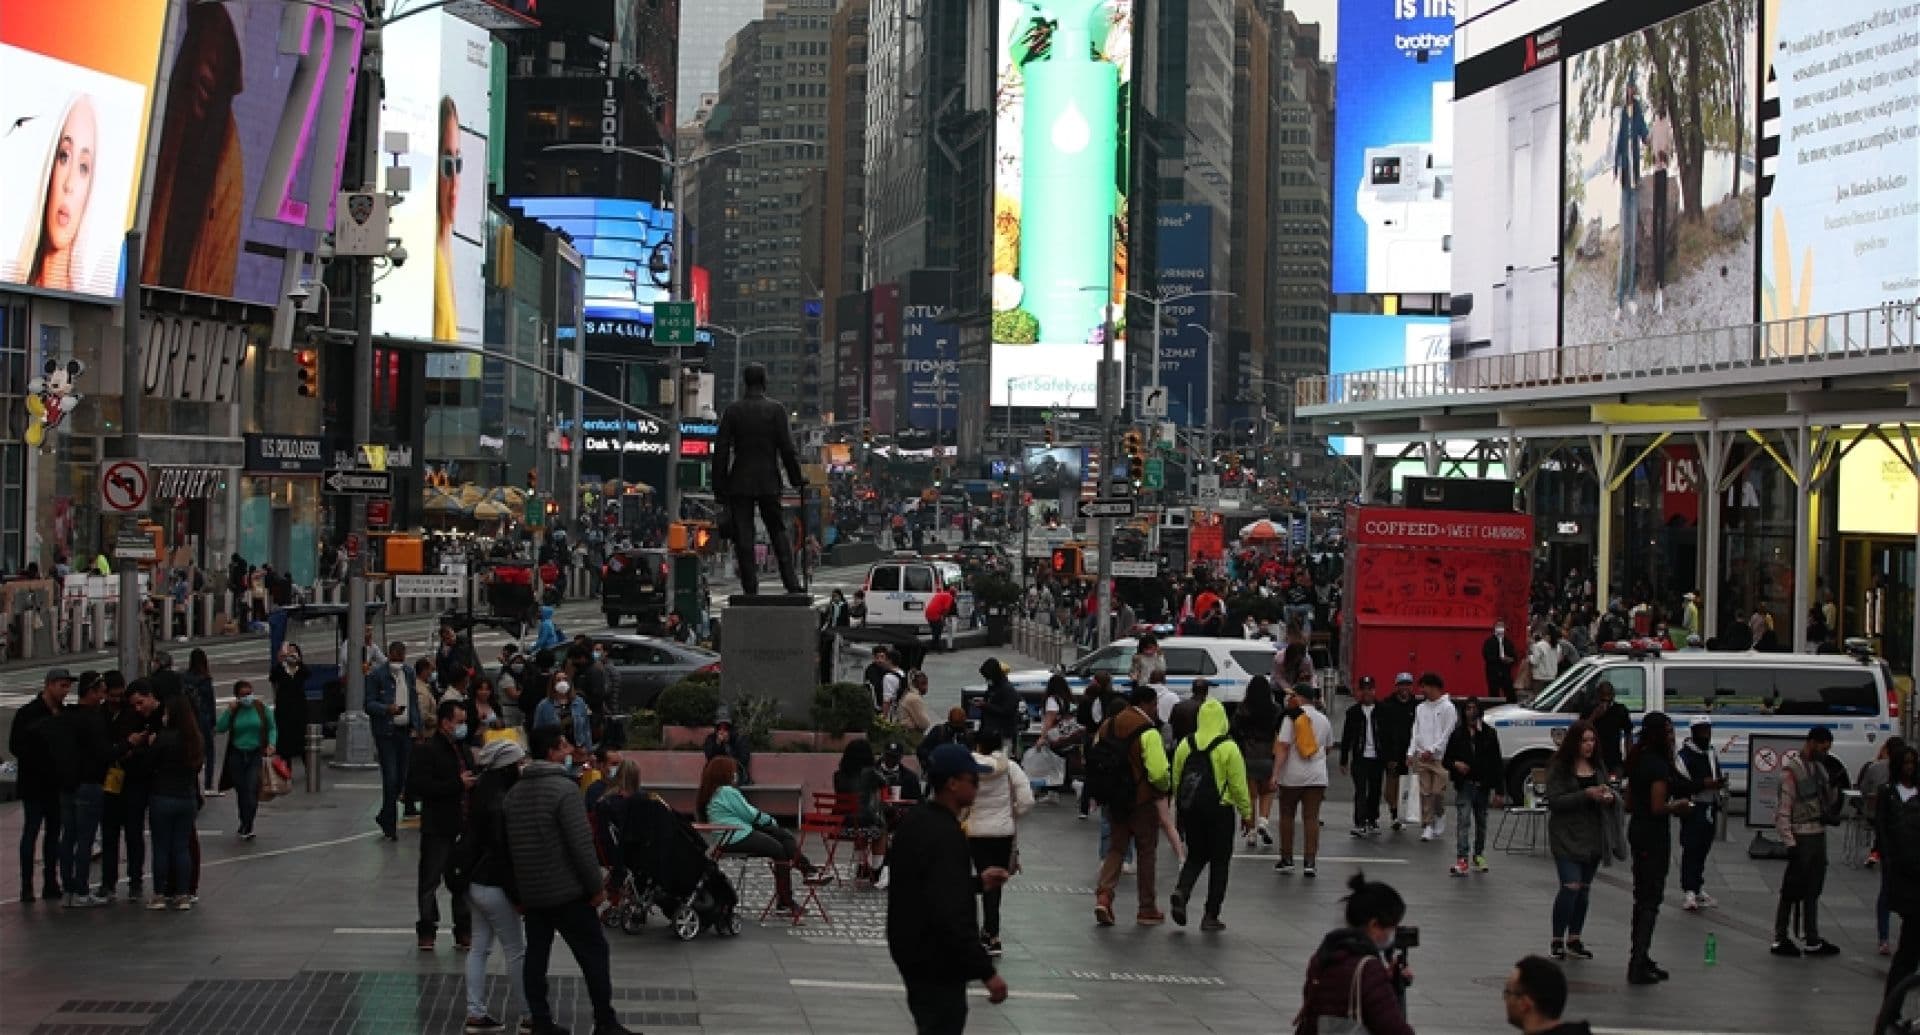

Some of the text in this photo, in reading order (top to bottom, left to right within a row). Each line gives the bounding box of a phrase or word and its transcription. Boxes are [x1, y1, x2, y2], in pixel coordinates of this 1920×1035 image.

[1395, 34, 1454, 49] brother
[362, 477, 386, 488] WAY
[1365, 521, 1438, 537] COFFEED
